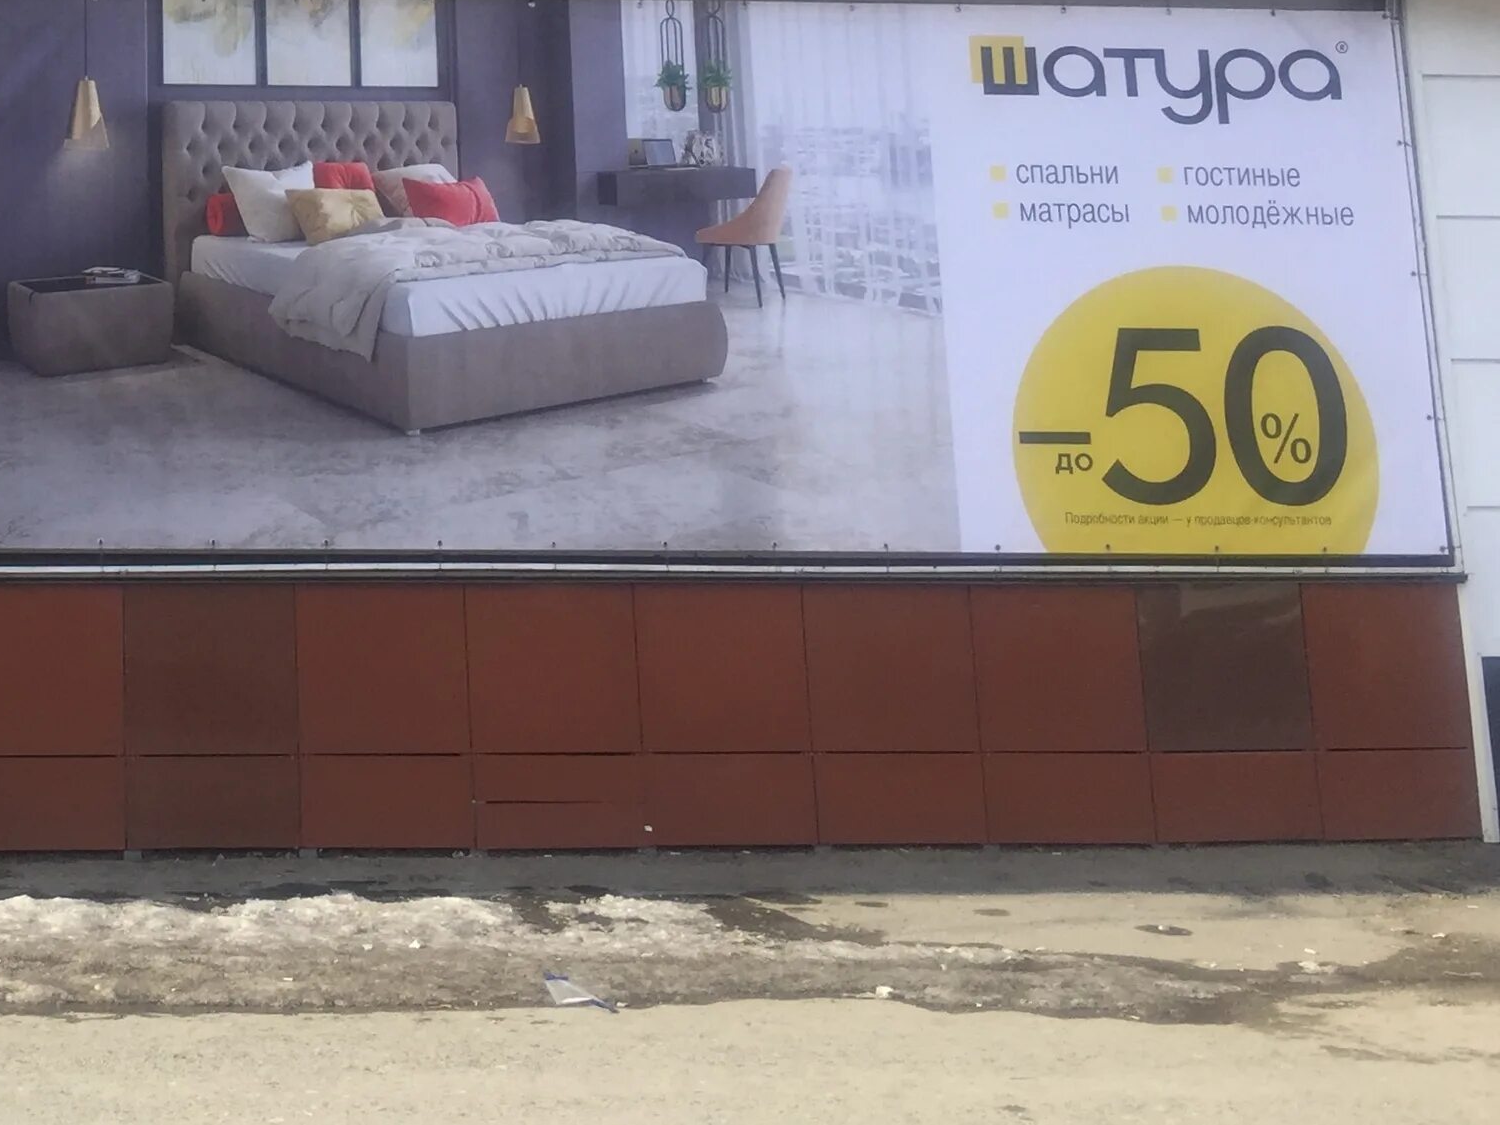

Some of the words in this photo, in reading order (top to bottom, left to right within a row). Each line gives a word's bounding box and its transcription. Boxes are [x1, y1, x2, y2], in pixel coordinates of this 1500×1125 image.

[1015, 164, 1120, 185] спальни
[1183, 165, 1301, 188] гостиные
[1019, 201, 1130, 229] матрасы
[1187, 200, 1355, 228] молодёжные
[1054, 452, 1094, 476] до
[1064, 511, 1136, 526] Подробности
[1137, 514, 1169, 526] акции
